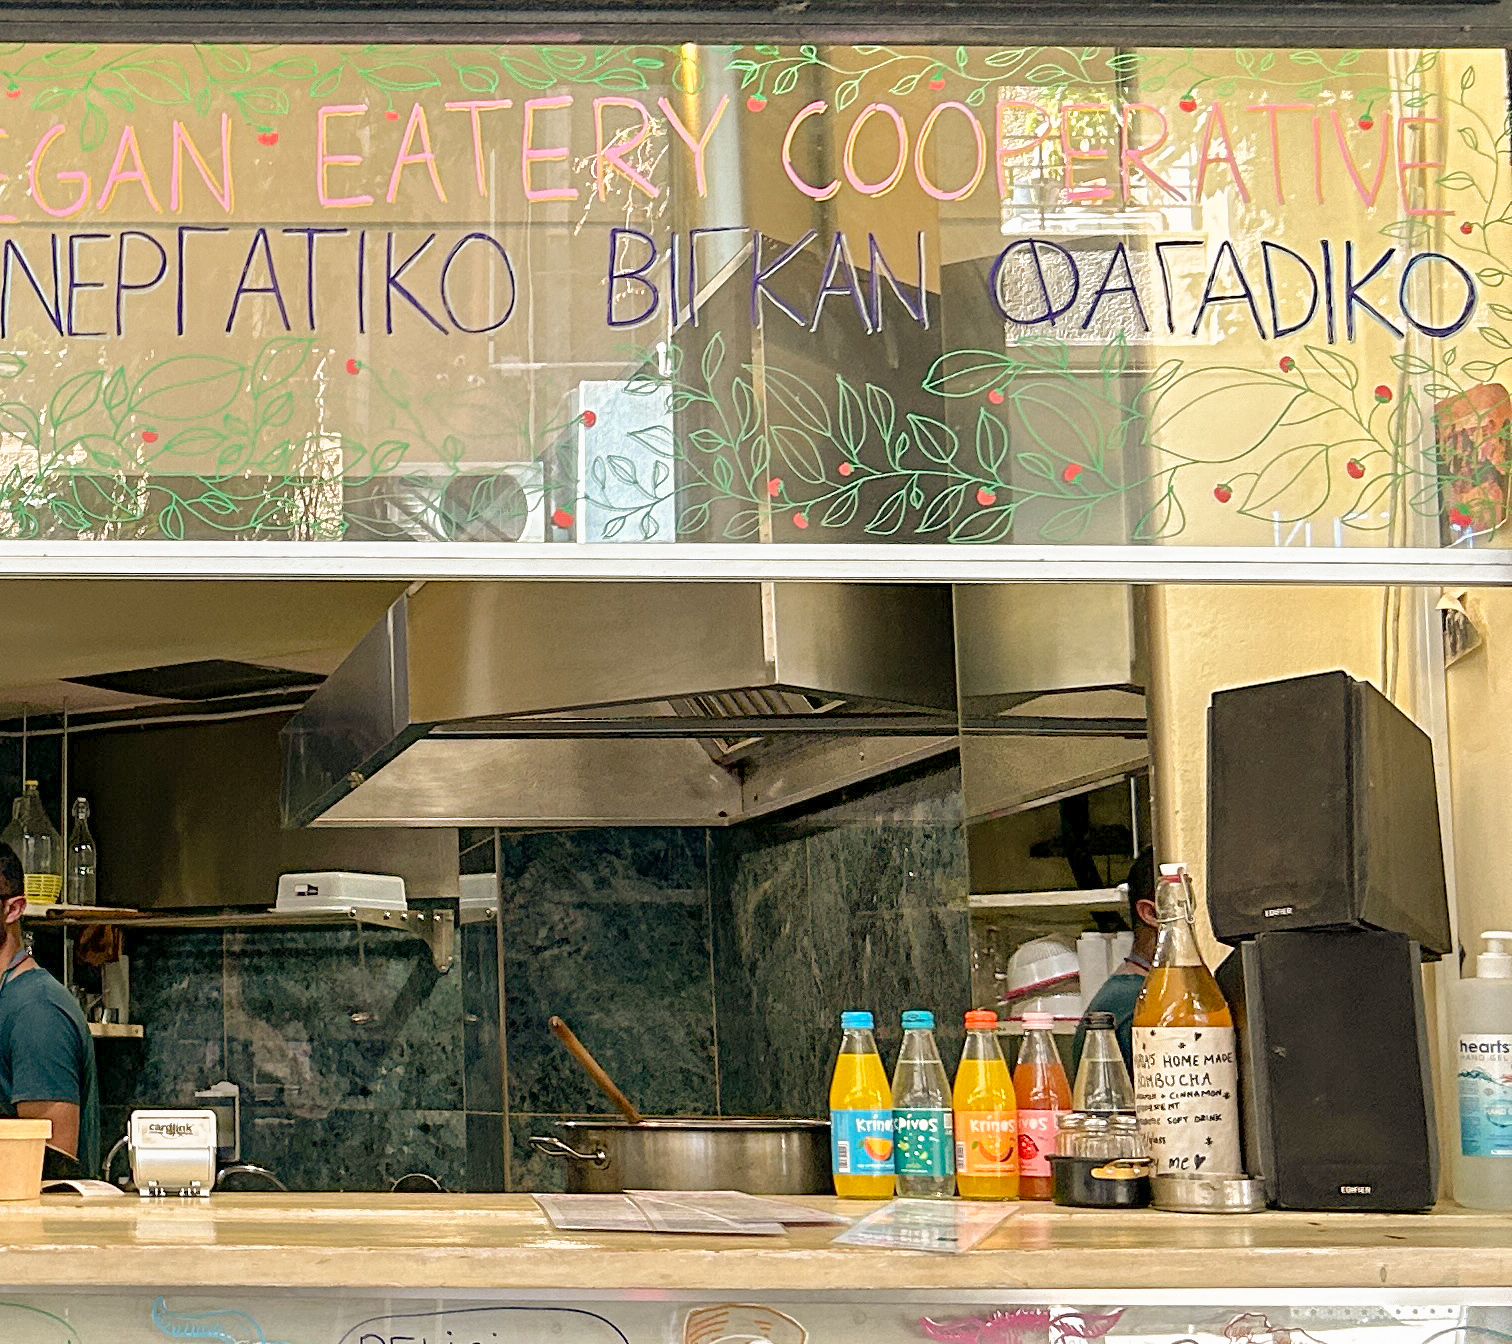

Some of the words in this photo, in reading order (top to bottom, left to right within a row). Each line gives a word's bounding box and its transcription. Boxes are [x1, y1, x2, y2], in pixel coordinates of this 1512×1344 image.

[316, 94, 730, 209] EATERY
[780, 99, 1456, 218] COOPERATIVE
[1163, 1054, 1199, 1068] HOME
[1204, 1052, 1233, 1066] MADE
